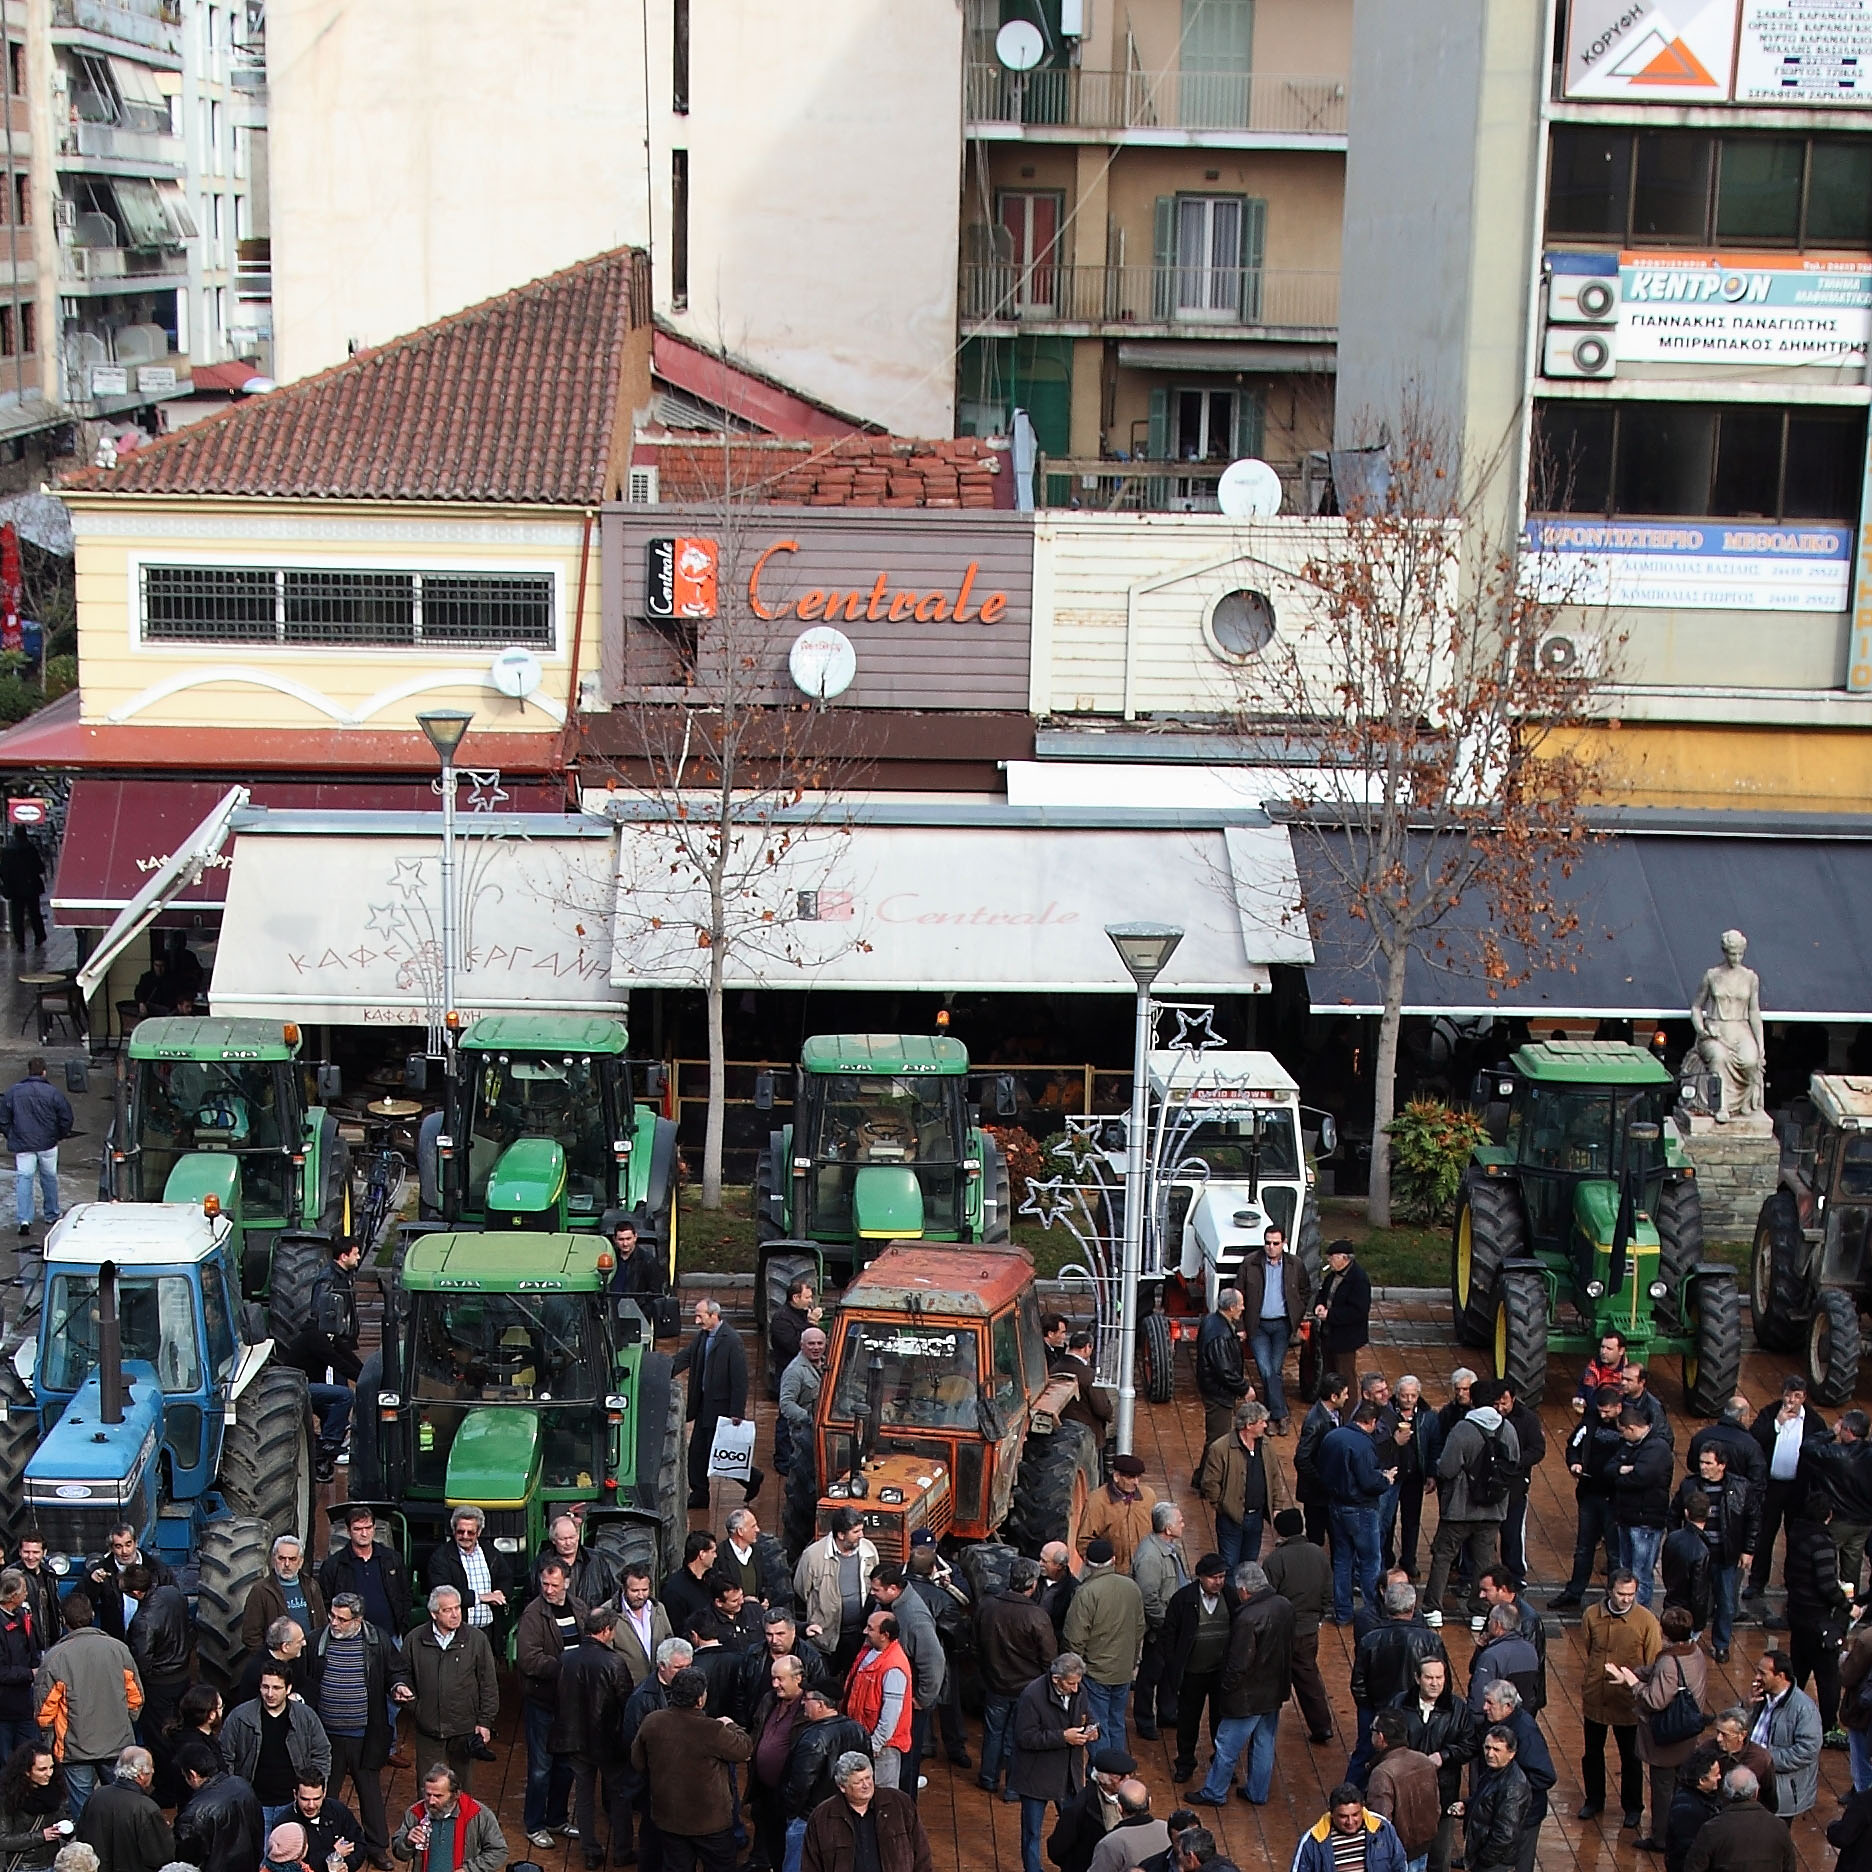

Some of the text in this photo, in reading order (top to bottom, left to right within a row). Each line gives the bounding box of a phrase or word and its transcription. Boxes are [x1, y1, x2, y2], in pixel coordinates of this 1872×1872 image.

[1580, 2, 1644, 66] ΚΟΡΥΦΗ
[1631, 314, 1838, 332] ΓΙΑΝΝΑΚΗΣ ΠΑΝΑΓΙΩΤΗΣ
[1658, 336, 1872, 353] ΜΠΙΡΜΠΑΚΟΣ ΔΗΜΗΤΡΗΣ
[1539, 525, 1840, 554] ΦΡΟΝΤΙΣΤΗΡΙΟ ΜΕΘΟΔΙΚΟ
[649, 542, 674, 615] Centrale
[748, 539, 1008, 624] Centrale
[877, 892, 1081, 926] Centrale
[288, 944, 402, 976] ΚΑΦΕ
[364, 1007, 404, 1023] ΚΑΦΕ
[713, 1448, 746, 1460] LOGO
